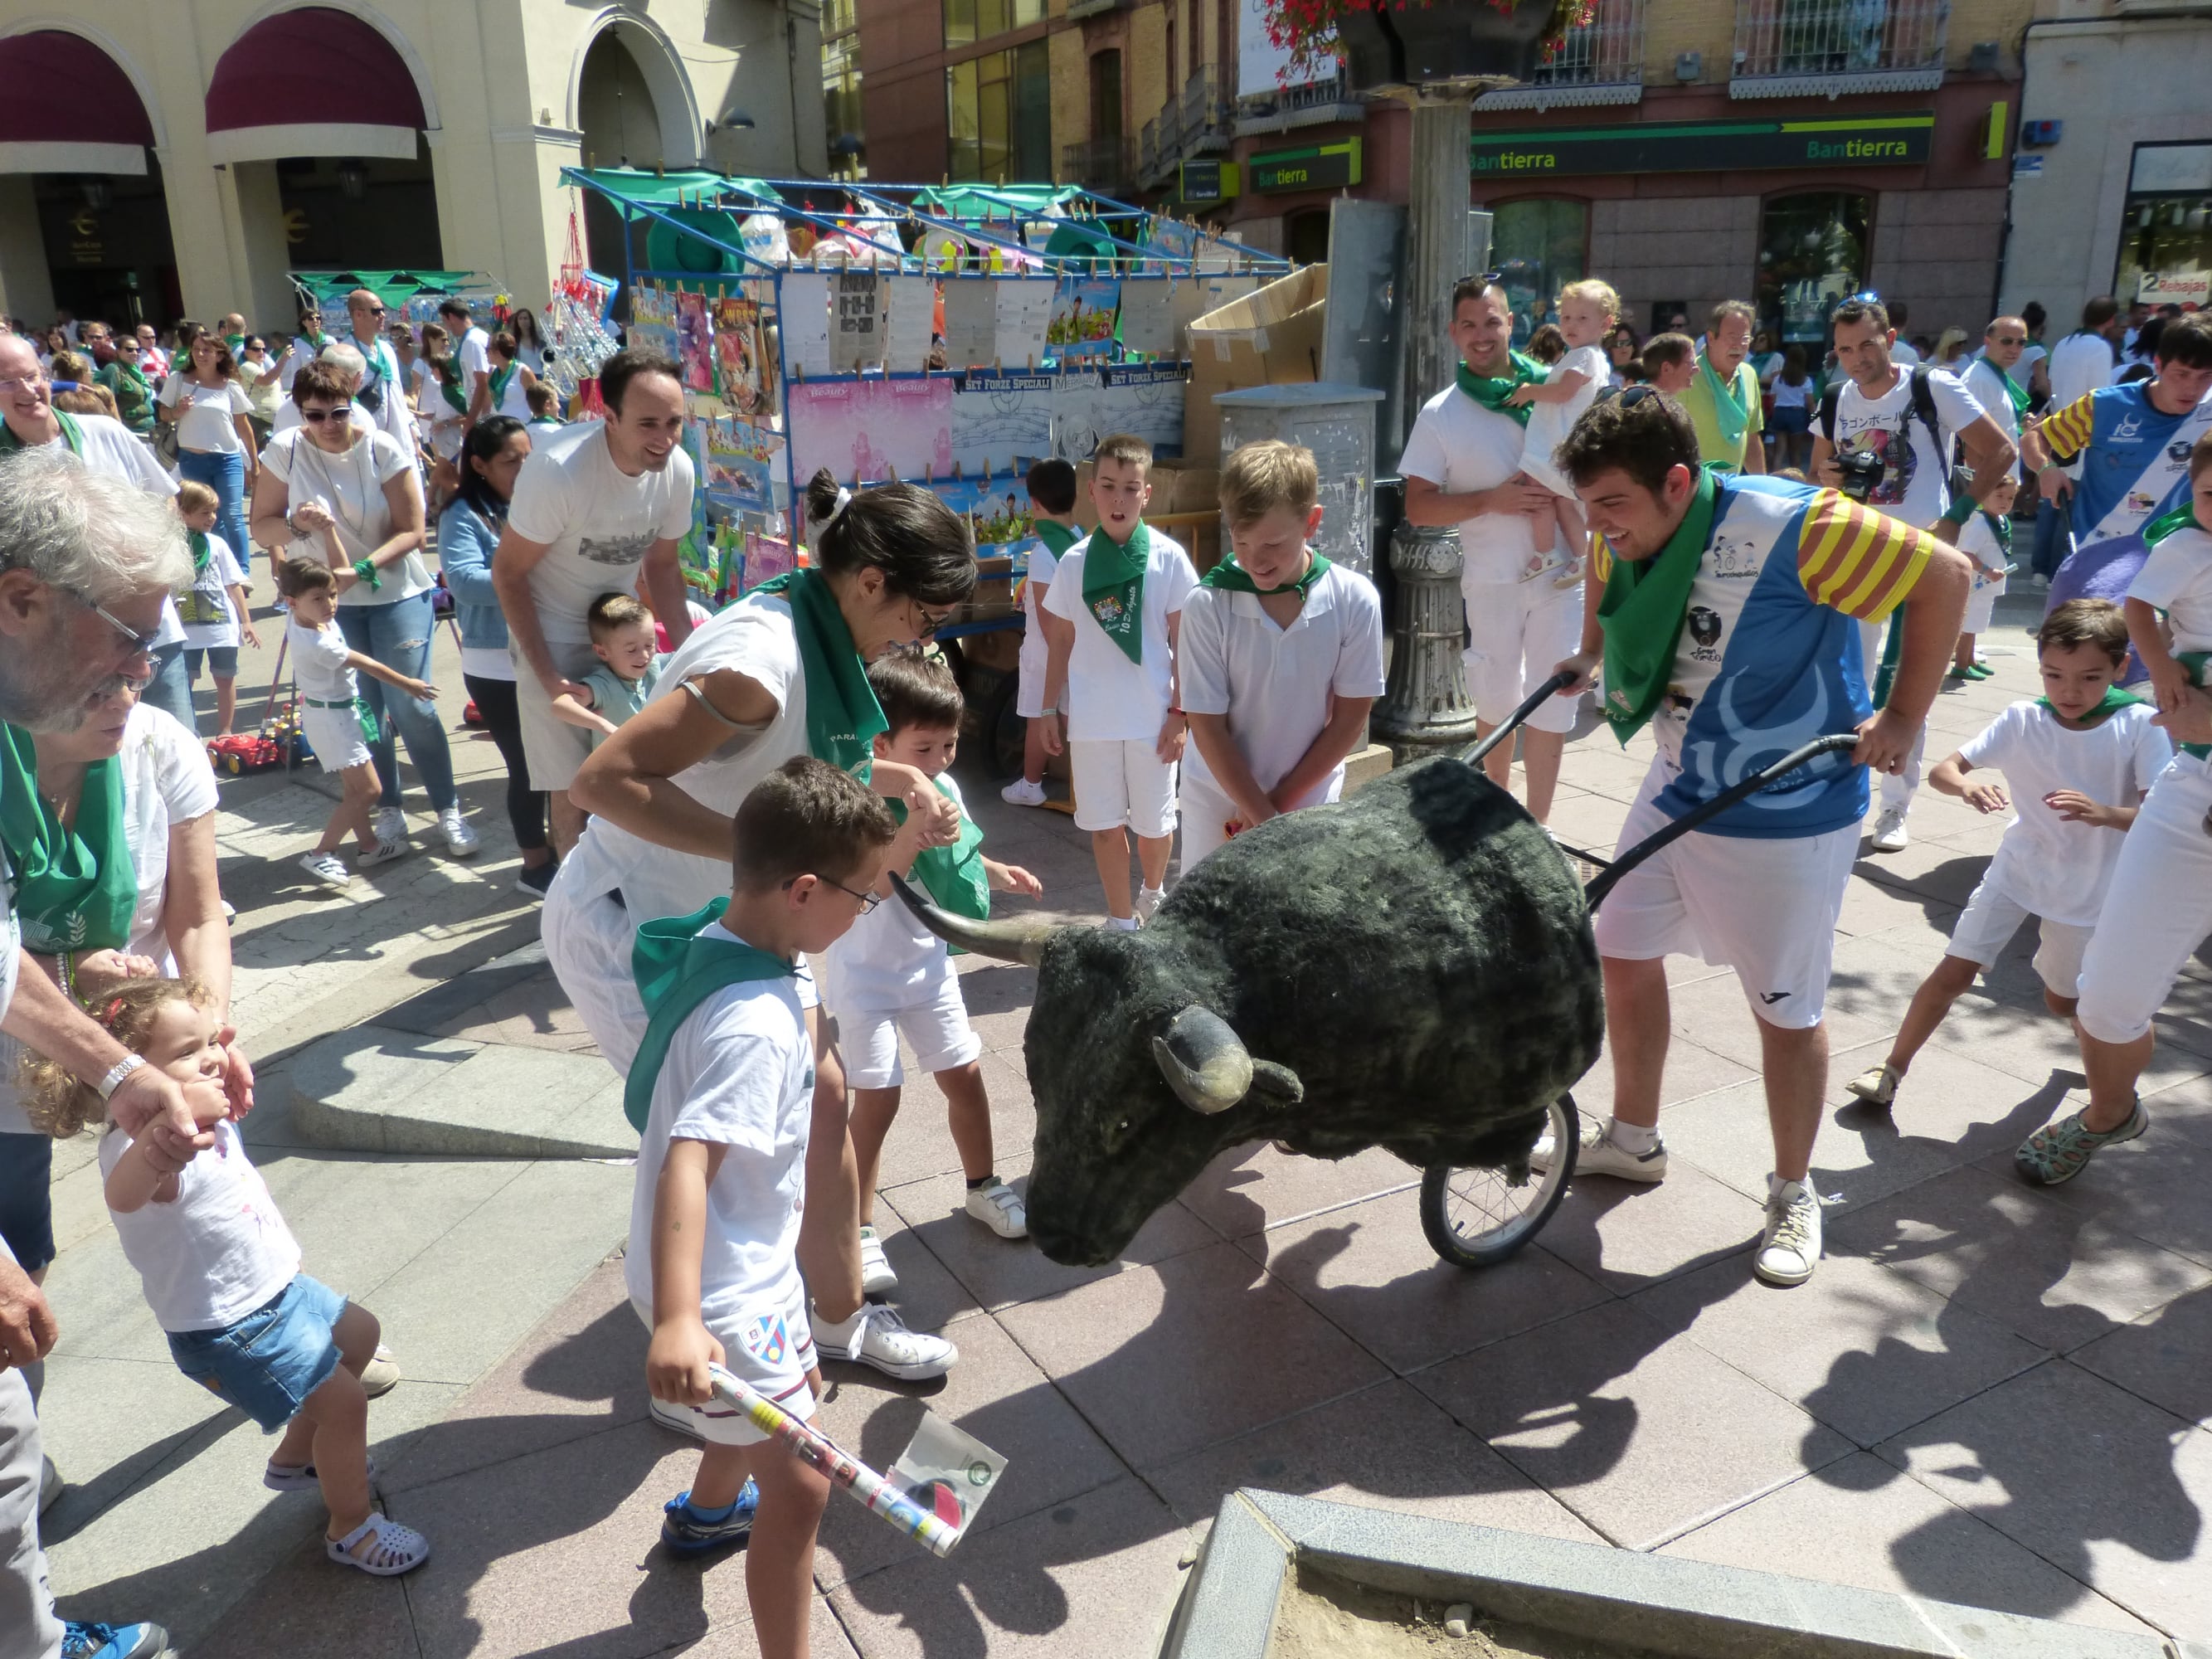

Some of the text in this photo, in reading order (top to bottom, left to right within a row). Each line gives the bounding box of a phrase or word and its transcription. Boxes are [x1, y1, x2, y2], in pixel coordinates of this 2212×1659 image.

[1806, 139, 1908, 159] Bantierra
[1258, 168, 1308, 187] Bantierra
[2142, 273, 2208, 295] 2 Rebajas
[1111, 368, 1186, 385] SET FORZE SPECIALI
[895, 383, 931, 394] Beauty
[965, 377, 1050, 391] SET FORZE SPECIALI
[811, 387, 848, 398] Beauty
[1120, 623, 1130, 634] 10
[830, 733, 858, 742] PARA
